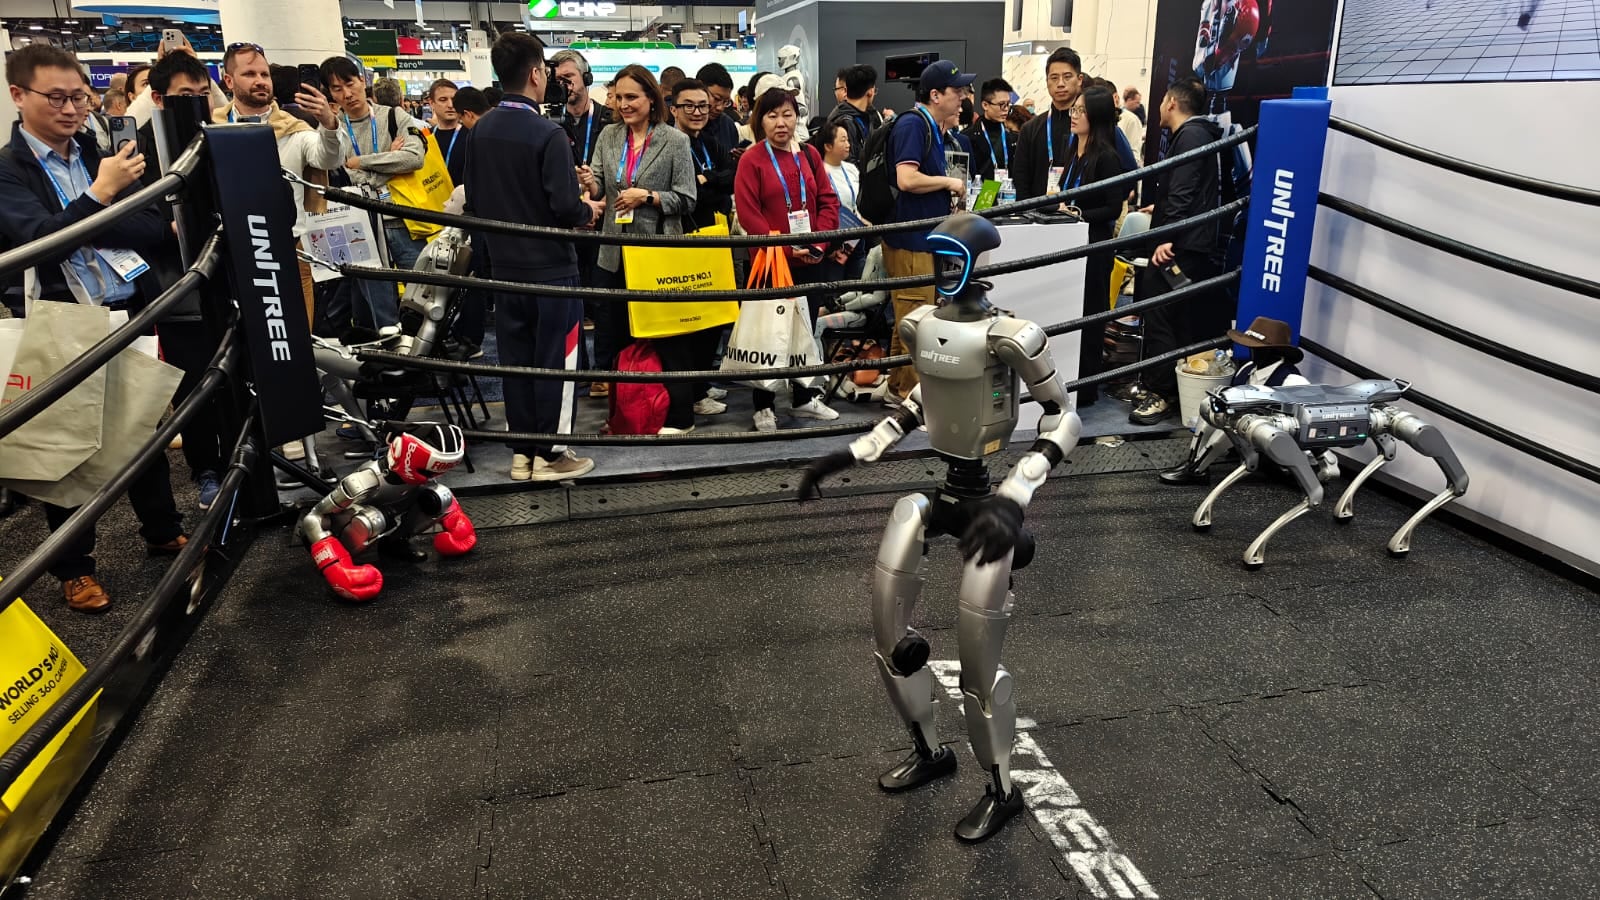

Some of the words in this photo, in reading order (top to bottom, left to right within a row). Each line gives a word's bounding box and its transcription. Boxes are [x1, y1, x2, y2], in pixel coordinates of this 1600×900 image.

[1262, 168, 1295, 293] UNITREE
[247, 214, 292, 361] UNITREE
[656, 274, 696, 285] WORLD'S
[696, 271, 712, 281] NO.1
[920, 349, 961, 365] UNITREE
[0, 657, 53, 711] WORLD'S
[8, 694, 40, 725] SELLING
[38, 679, 57, 698] 360
